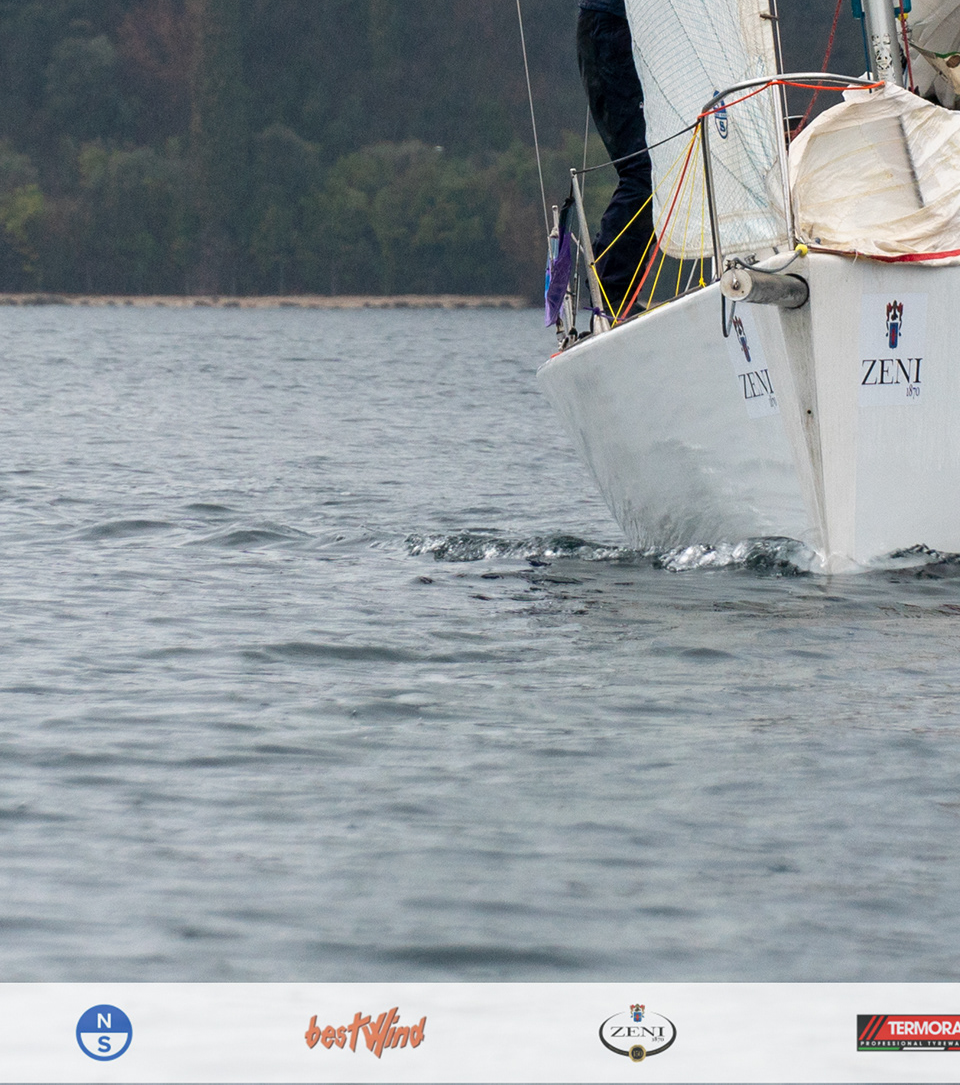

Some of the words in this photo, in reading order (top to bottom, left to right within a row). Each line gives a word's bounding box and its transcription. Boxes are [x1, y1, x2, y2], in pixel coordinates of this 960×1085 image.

[738, 369, 774, 399] ZENI
[861, 358, 923, 385] ZENI
[906, 384, 920, 399] 1870
